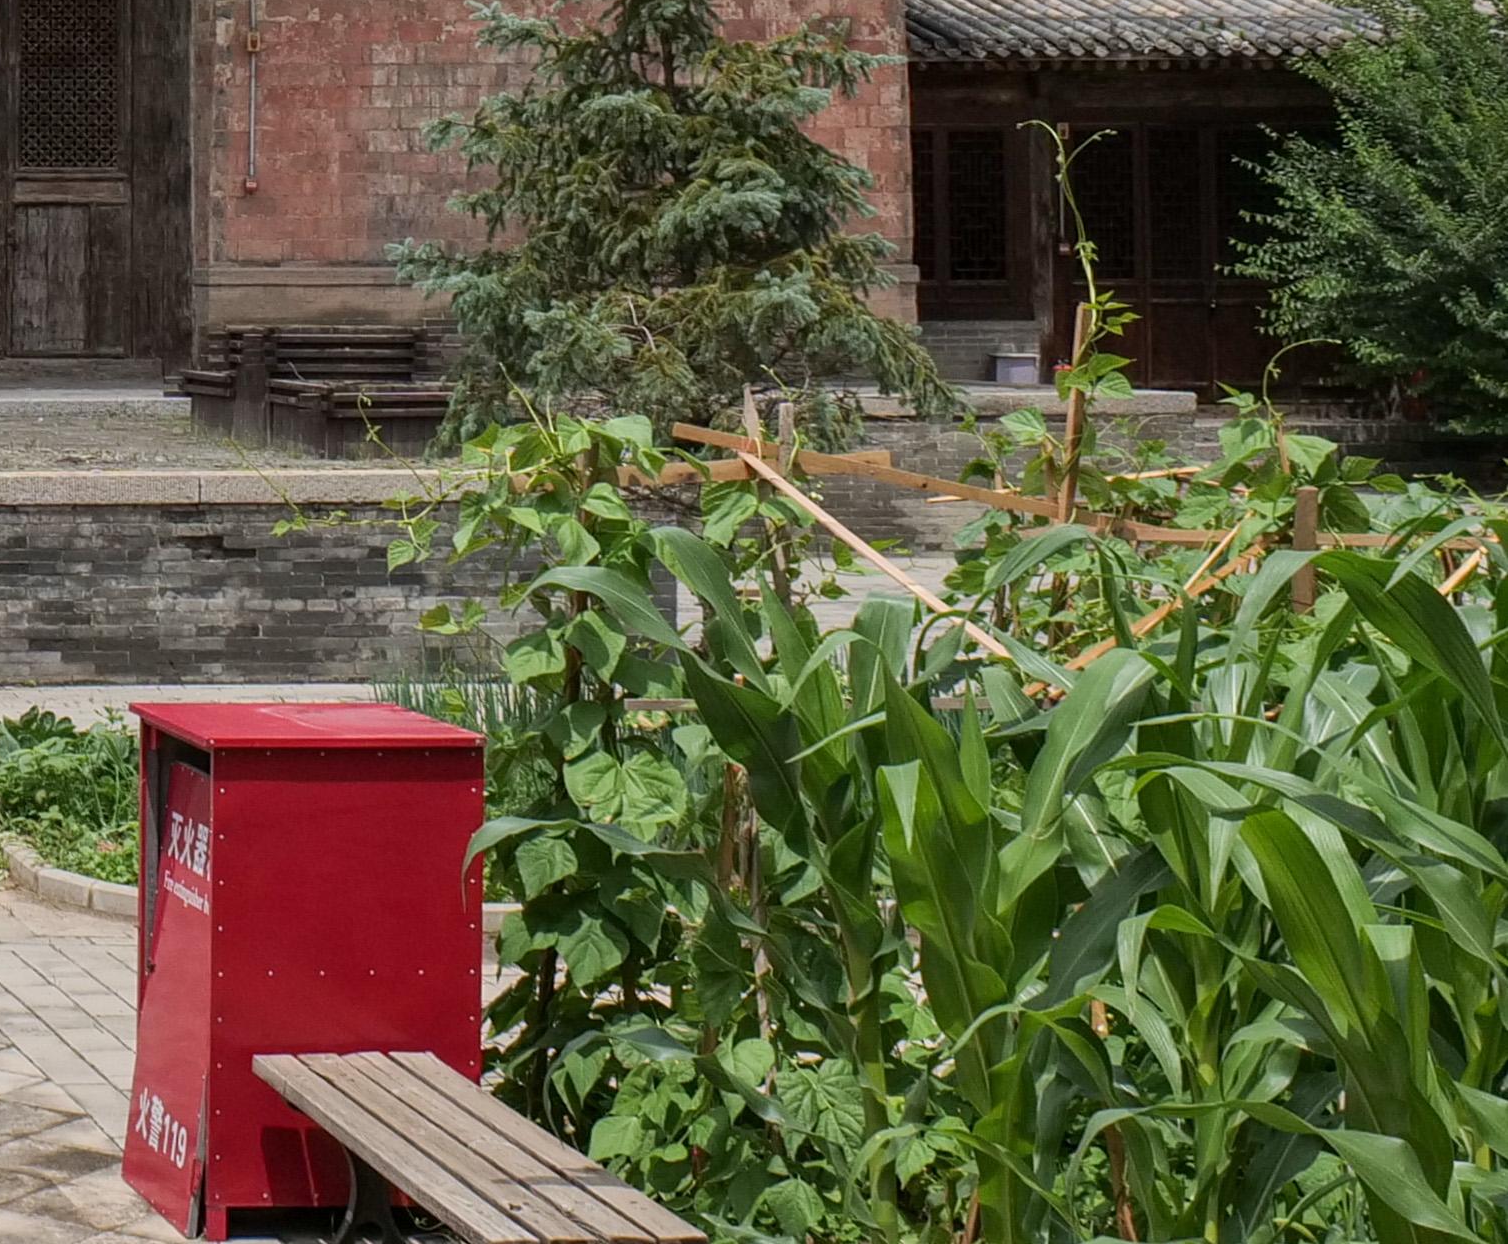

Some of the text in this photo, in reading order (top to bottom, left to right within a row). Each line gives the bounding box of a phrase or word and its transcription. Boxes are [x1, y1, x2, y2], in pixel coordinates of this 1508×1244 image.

[167, 810, 211, 882] 灭火器
[135, 1086, 188, 1170] 火警119
